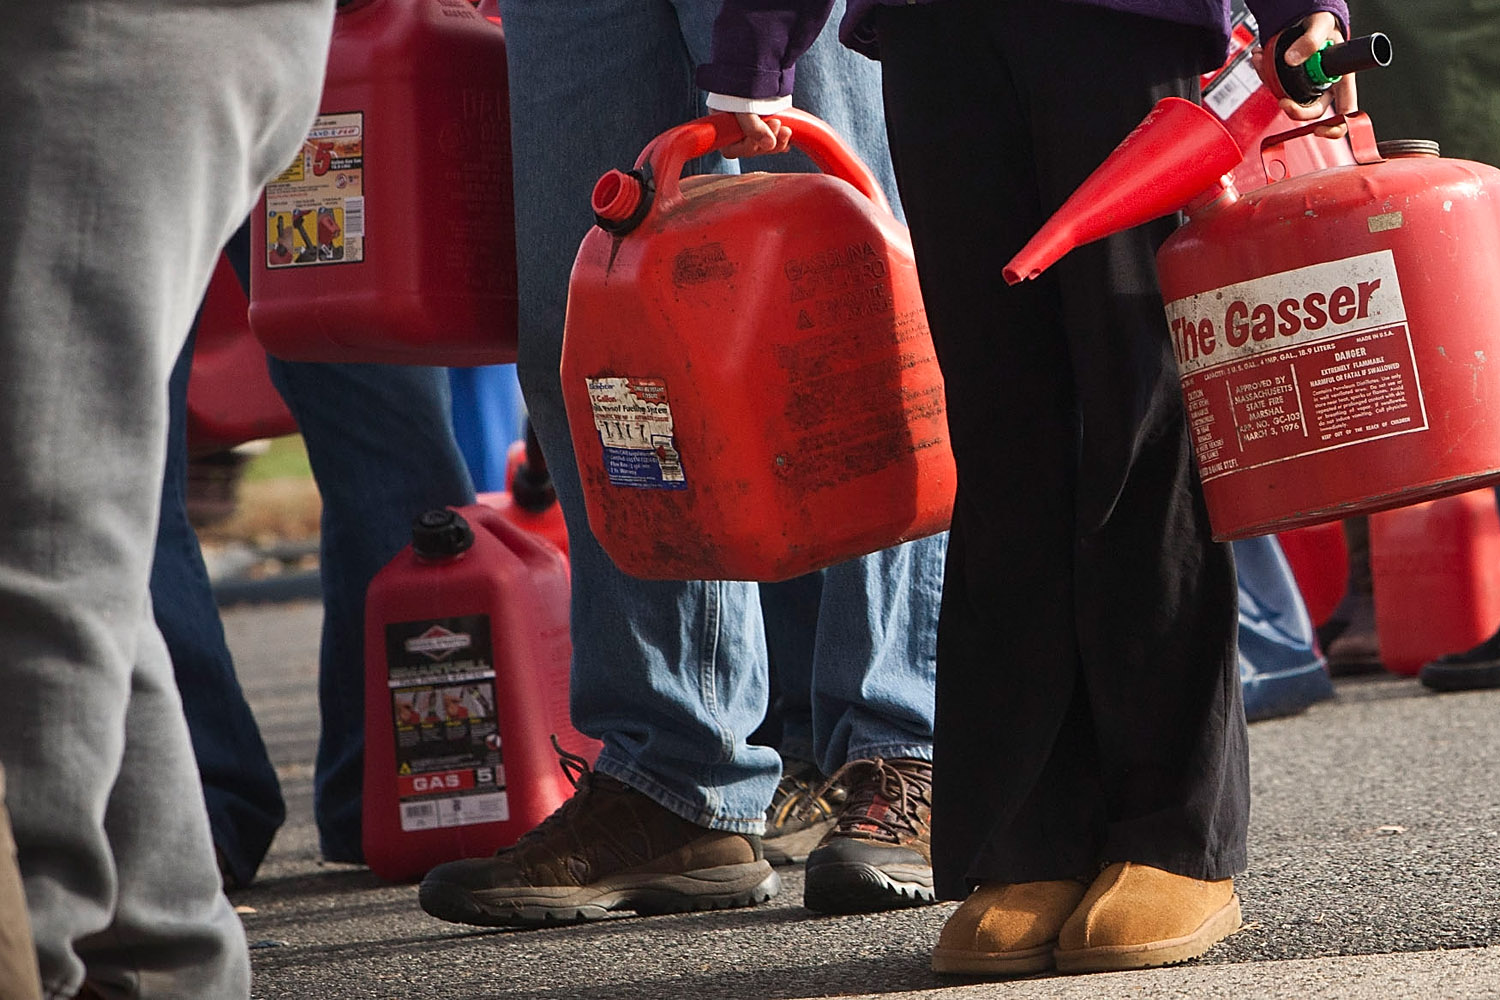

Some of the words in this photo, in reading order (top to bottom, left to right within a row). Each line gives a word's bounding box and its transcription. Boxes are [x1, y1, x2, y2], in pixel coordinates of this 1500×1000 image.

[312, 142, 335, 176] 5
[1172, 316, 1216, 364] The
[1224, 278, 1382, 348] Gasser
[1313, 342, 1336, 353] LITERS
[1334, 346, 1366, 362] DANGER
[1352, 355, 1384, 368] FLAMMABLE
[1309, 376, 1335, 387] HARMFUL
[1335, 374, 1343, 382] OR
[1343, 370, 1361, 380] FATAL
[1367, 361, 1400, 375] SWALLOWED
[1234, 378, 1272, 393] APPROVED
[1274, 375, 1286, 383] BY
[1233, 383, 1293, 404] MASSACHUSETTS
[1245, 399, 1266, 411] STATE
[1268, 395, 1284, 405] FIRE
[1248, 405, 1284, 420] MARSHAL
[1255, 419, 1270, 428] NO.
[1272, 412, 1300, 424] GC-103
[1242, 429, 1268, 441] MARCH
[1280, 422, 1299, 432] 1976
[413, 774, 460, 791] GAS
[477, 768, 493, 782] 5
